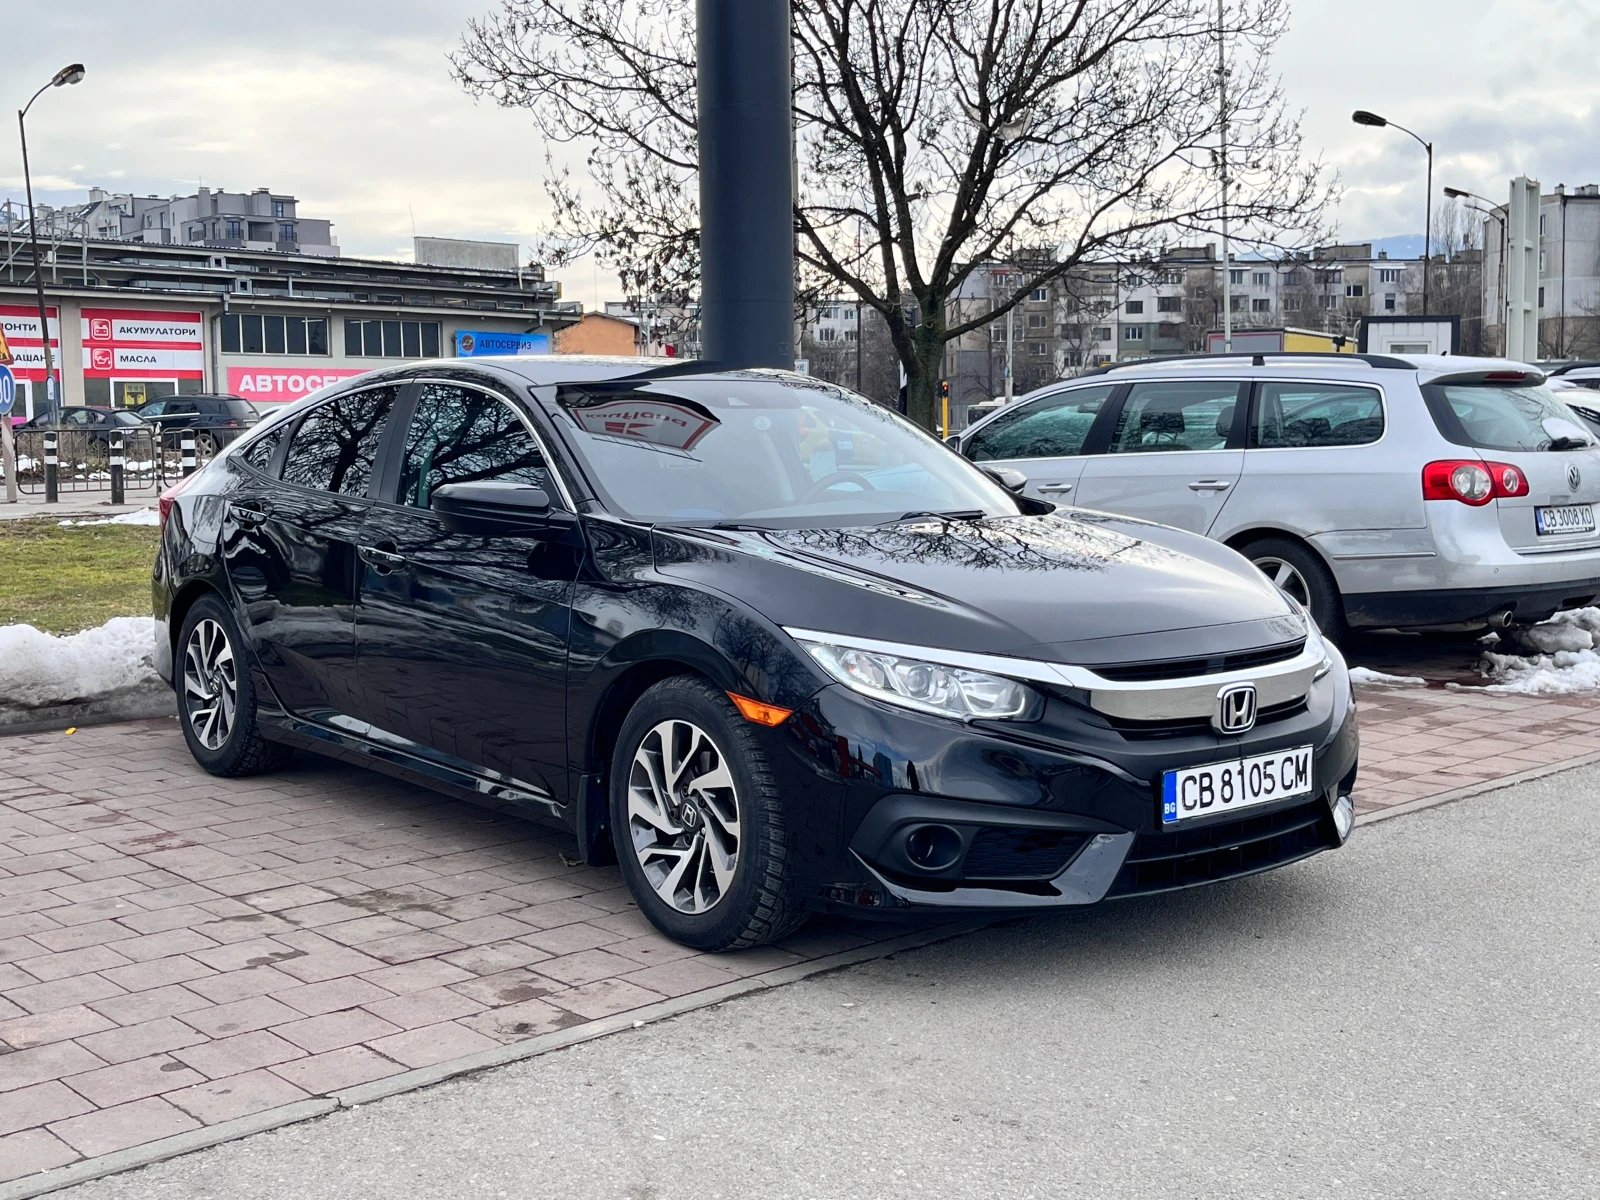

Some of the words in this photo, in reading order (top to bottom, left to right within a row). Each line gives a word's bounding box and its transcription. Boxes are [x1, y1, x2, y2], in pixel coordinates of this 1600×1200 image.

[1, 323, 37, 331] ОНТИ
[119, 326, 196, 336] АКУМУЛАТОРИ
[479, 340, 532, 350] АВТОСЕРВИЗ
[14, 354, 56, 363] АЩАНЕ
[119, 355, 157, 363] МАСЛА
[0, 375, 11, 404] 0
[238, 375, 348, 393] АВТОСЕ
[1557, 508, 1579, 526] 3008
[1181, 772, 1215, 811] CB
[1220, 760, 1276, 804] 8105
[1281, 752, 1309, 791] CM
[1164, 802, 1176, 814] BG
